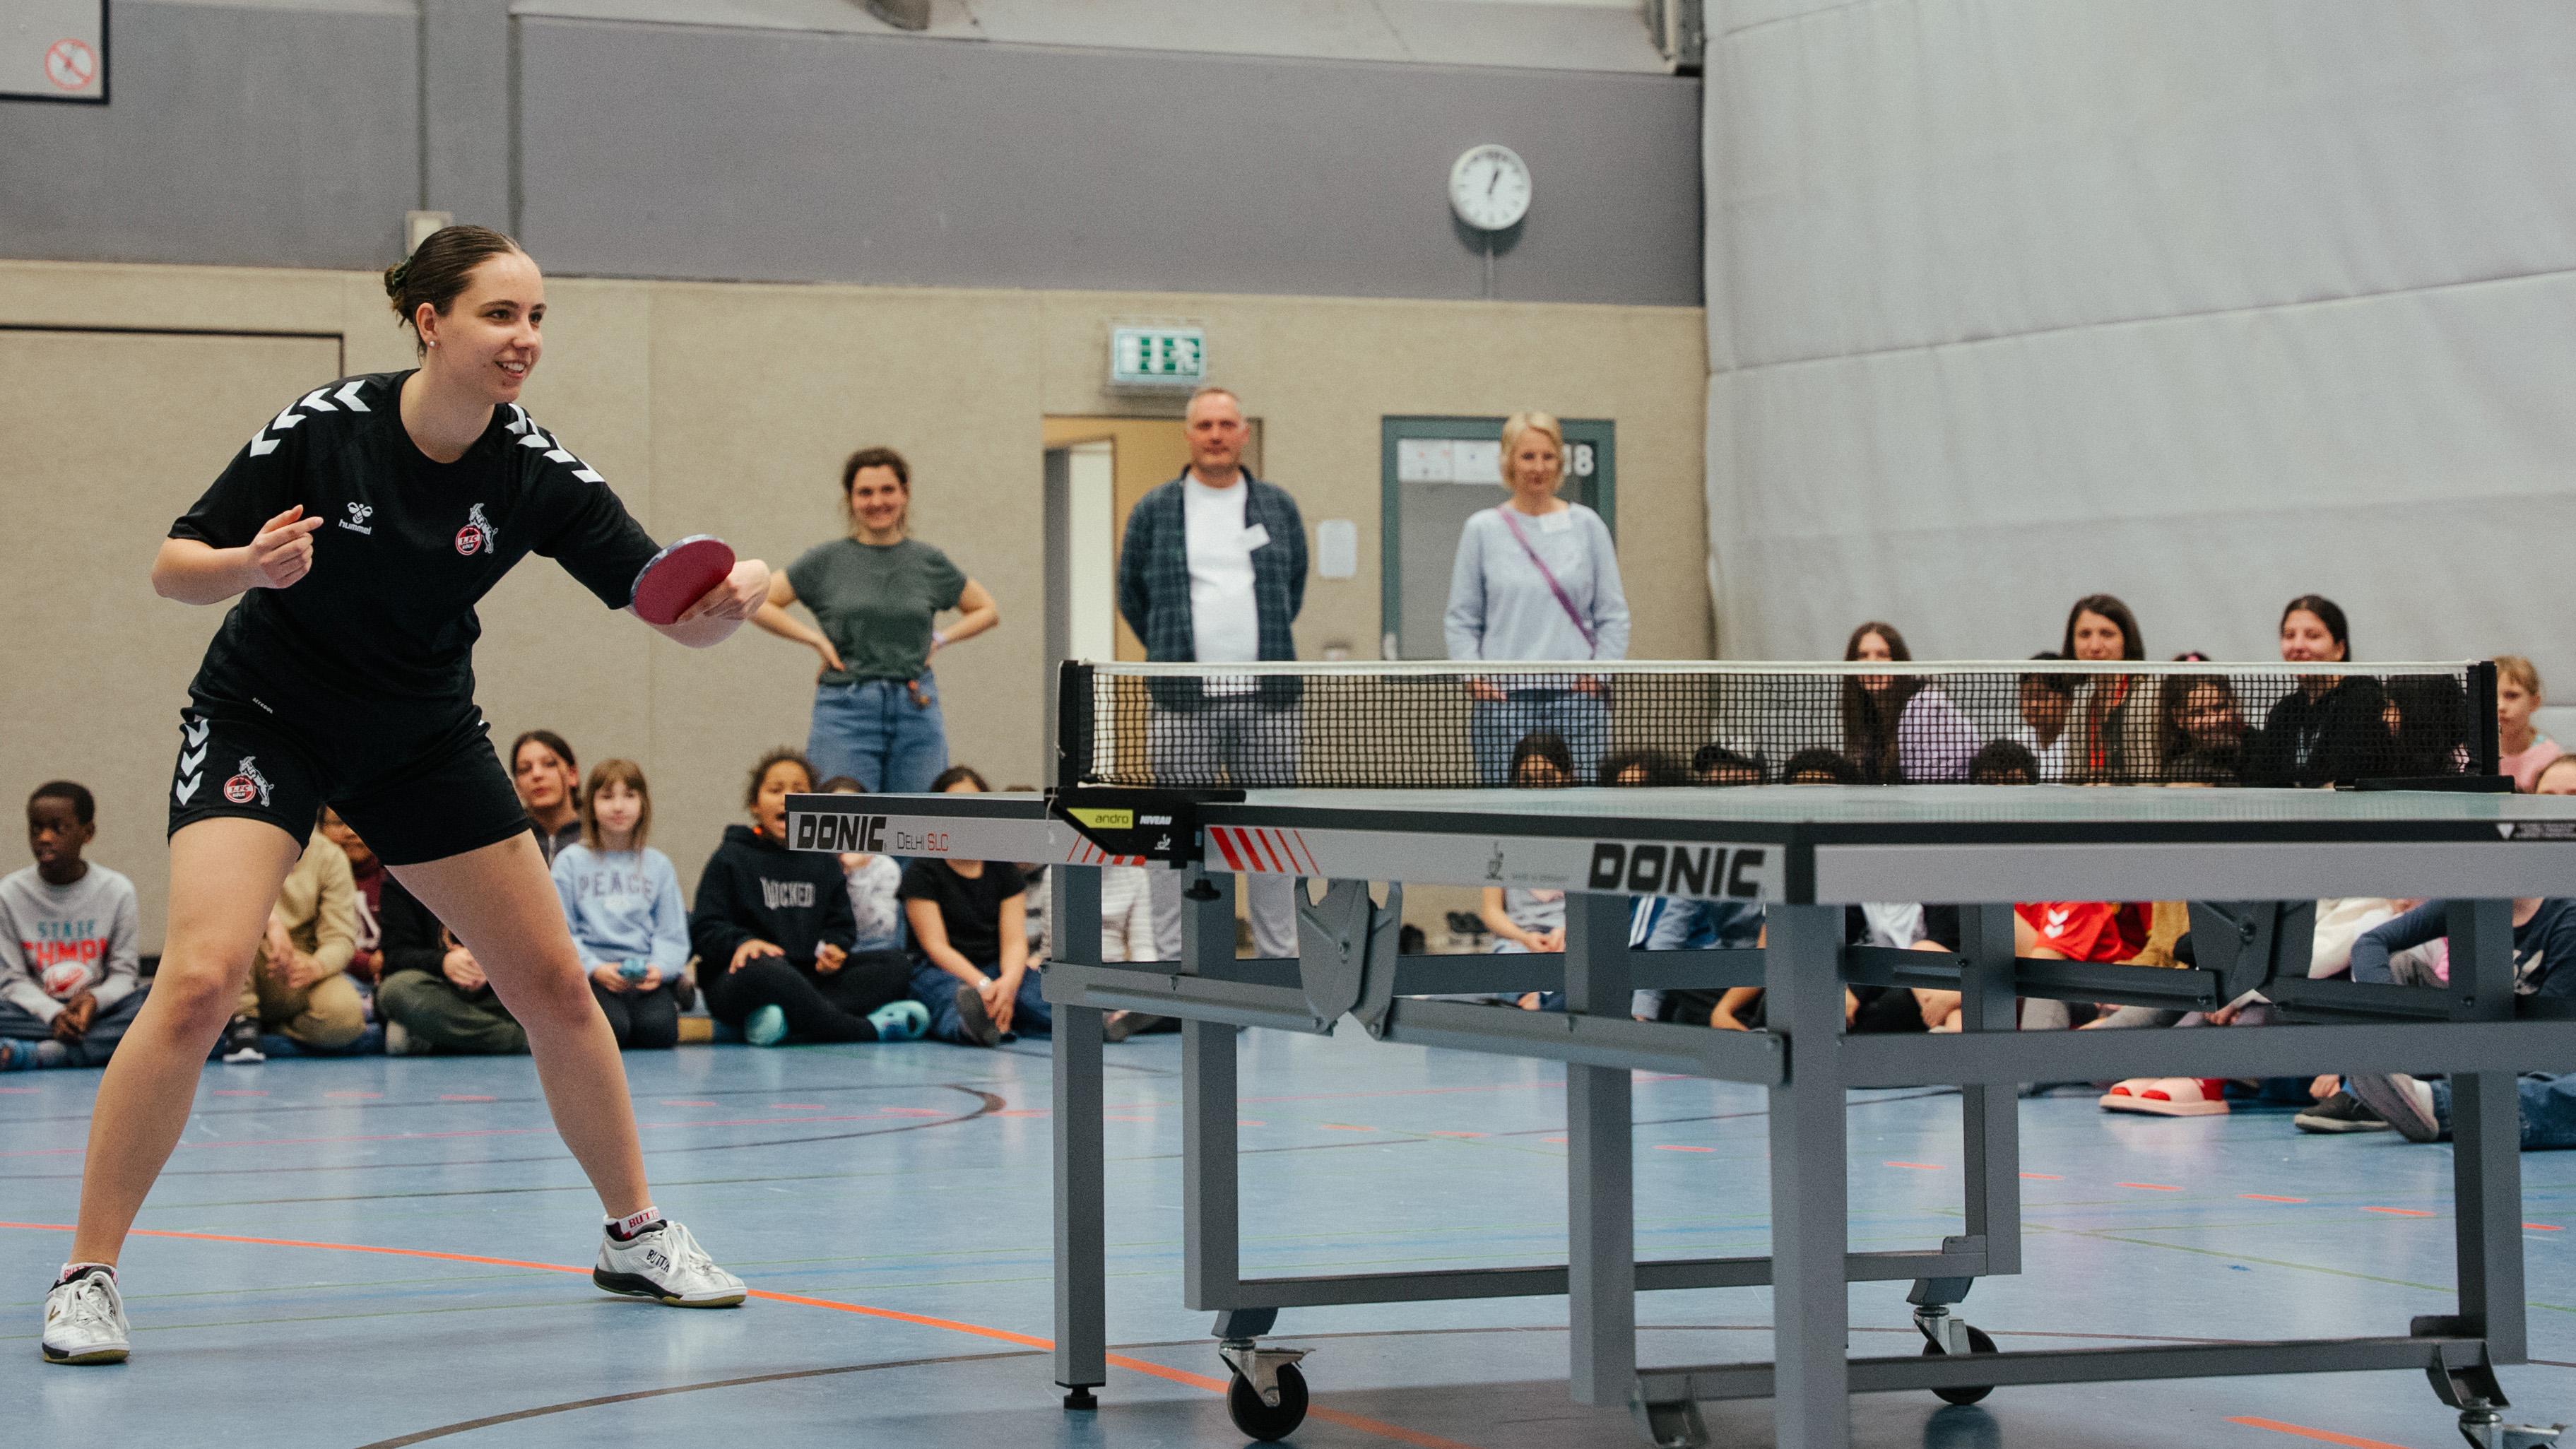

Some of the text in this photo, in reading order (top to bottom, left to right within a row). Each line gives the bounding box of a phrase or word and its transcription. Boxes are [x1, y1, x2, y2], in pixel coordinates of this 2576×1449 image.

[338, 519, 372, 535] hummel
[1095, 814, 1129, 824] andro
[1139, 815, 1172, 825] NIVEAU
[797, 815, 887, 852] DONIC
[927, 834, 949, 851] SLC
[1588, 843, 1766, 897] DONIC
[578, 870, 653, 903] PEACE
